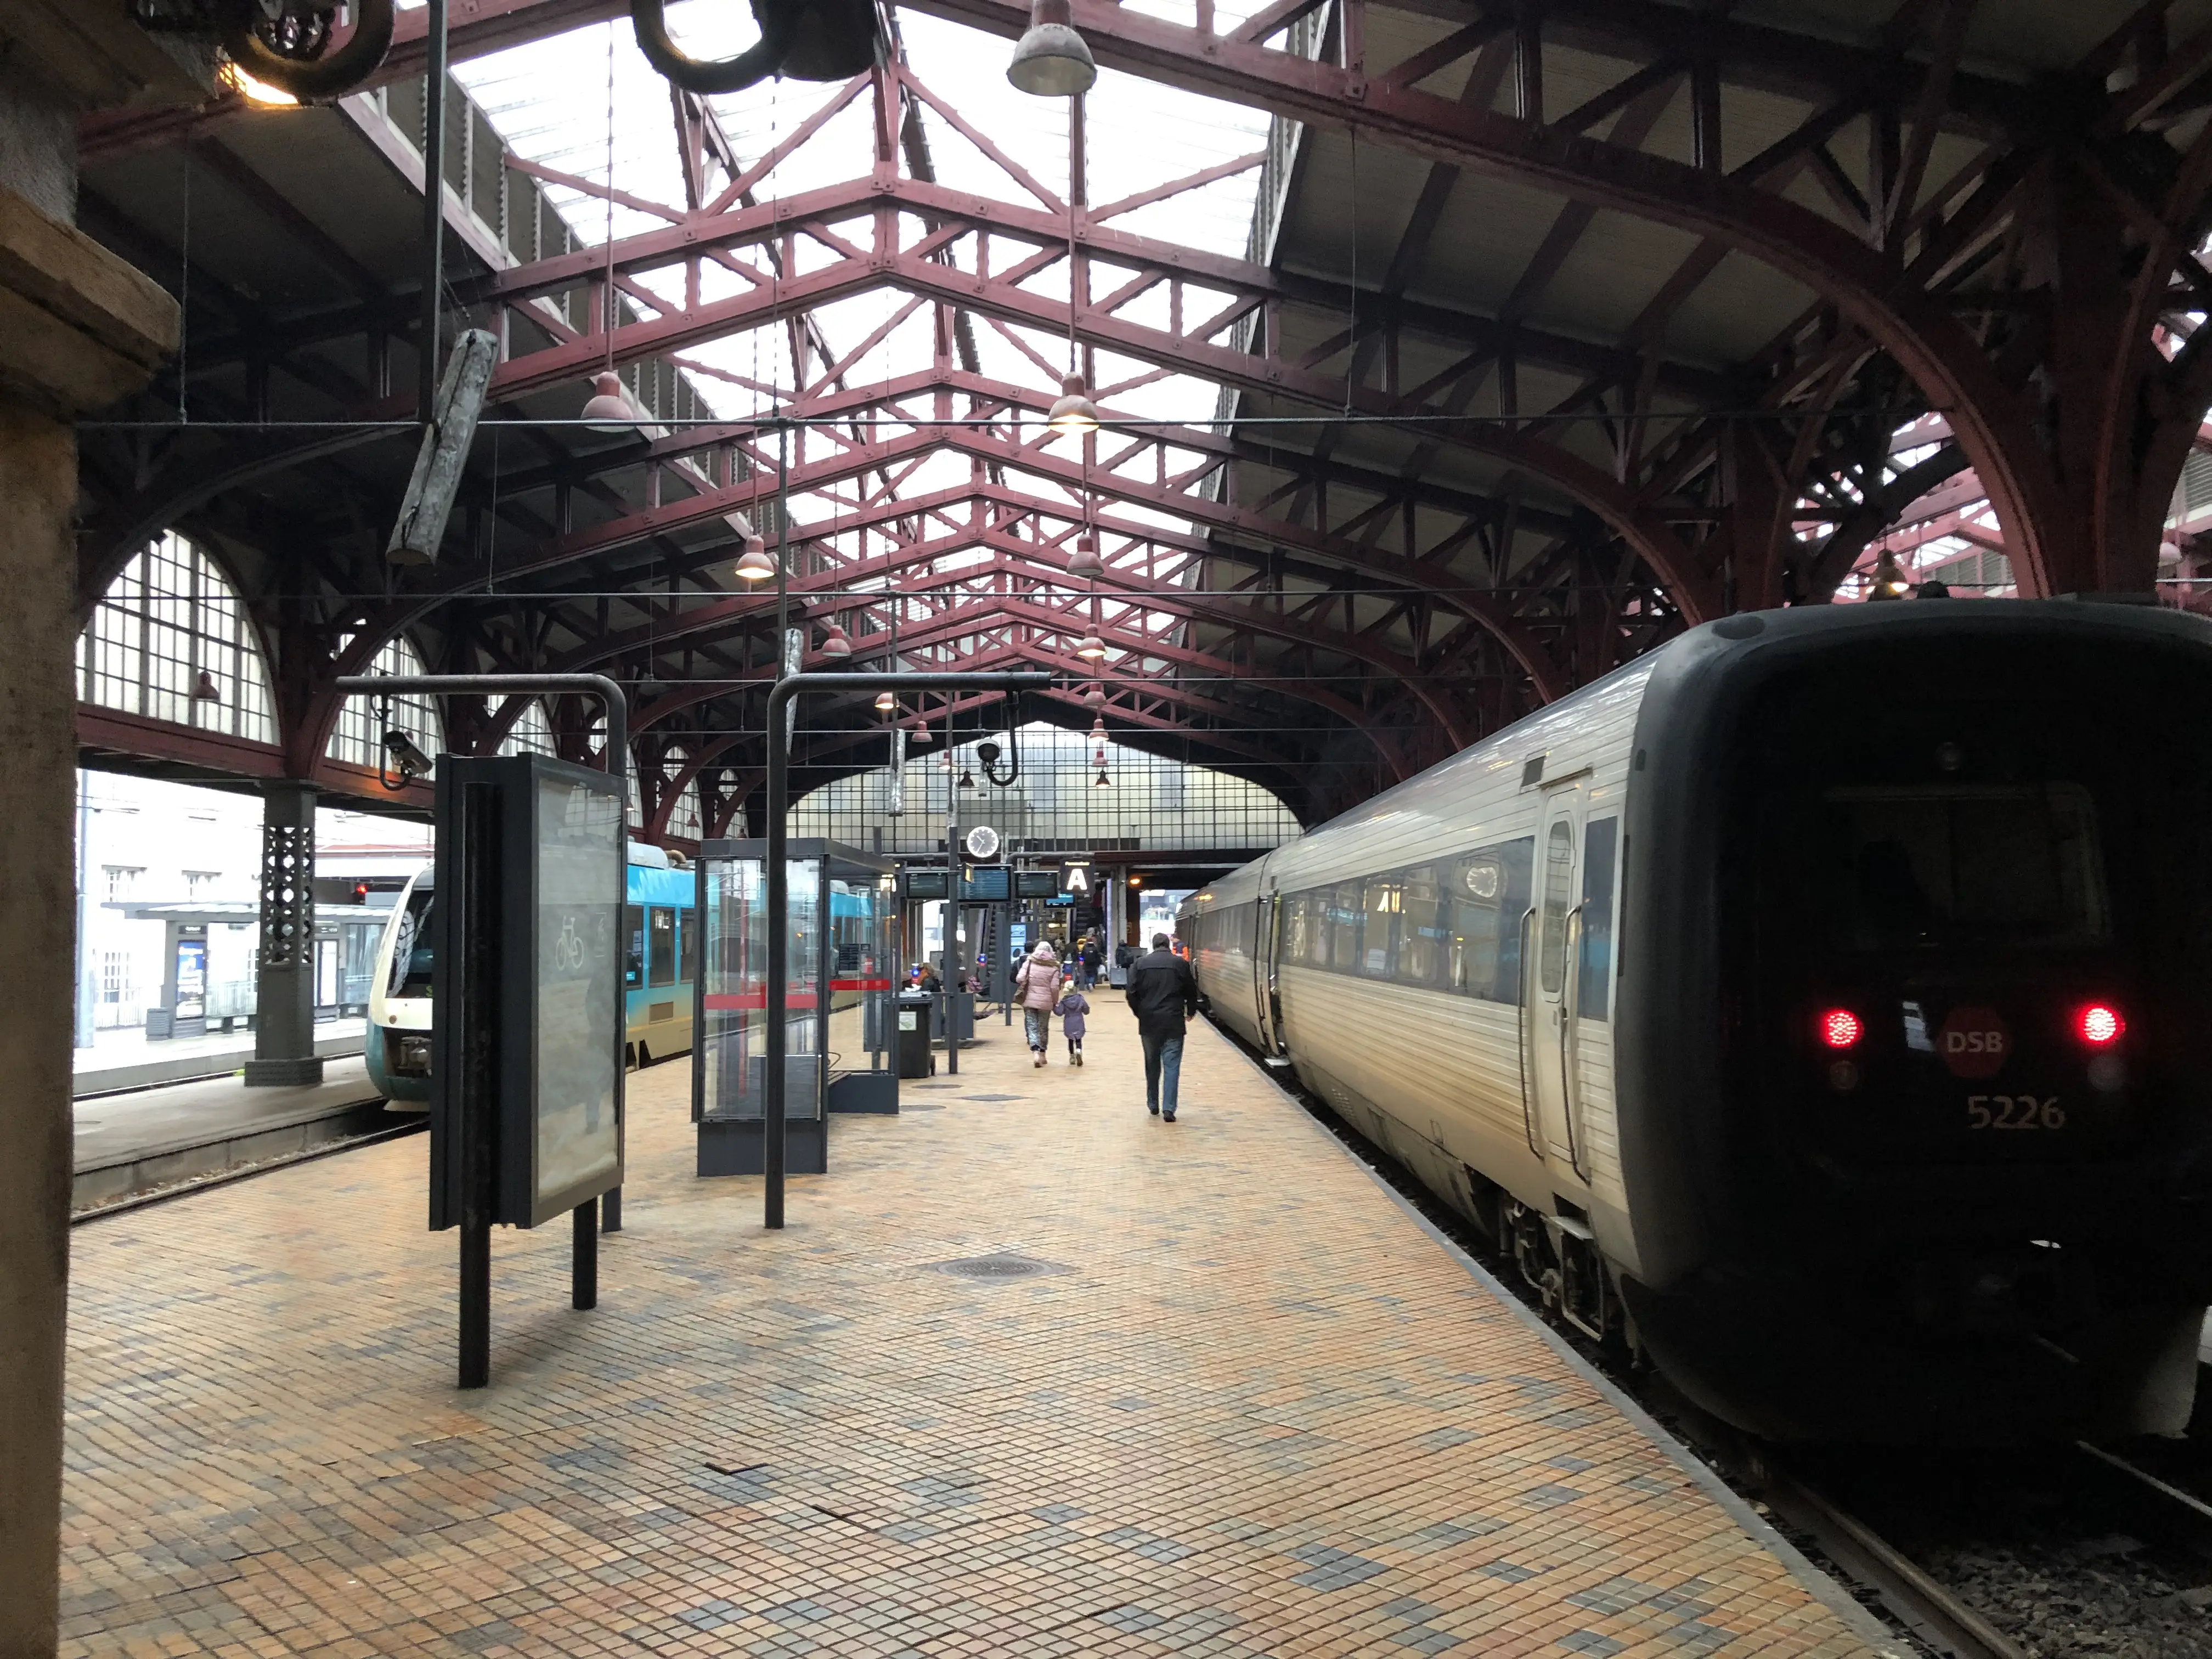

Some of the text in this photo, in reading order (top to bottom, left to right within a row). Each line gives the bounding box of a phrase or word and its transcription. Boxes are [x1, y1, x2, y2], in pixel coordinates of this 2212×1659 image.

[1066, 868, 1087, 890] A
[1946, 1031, 2003, 1053] DSB
[1967, 1094, 2066, 1130] 5226
